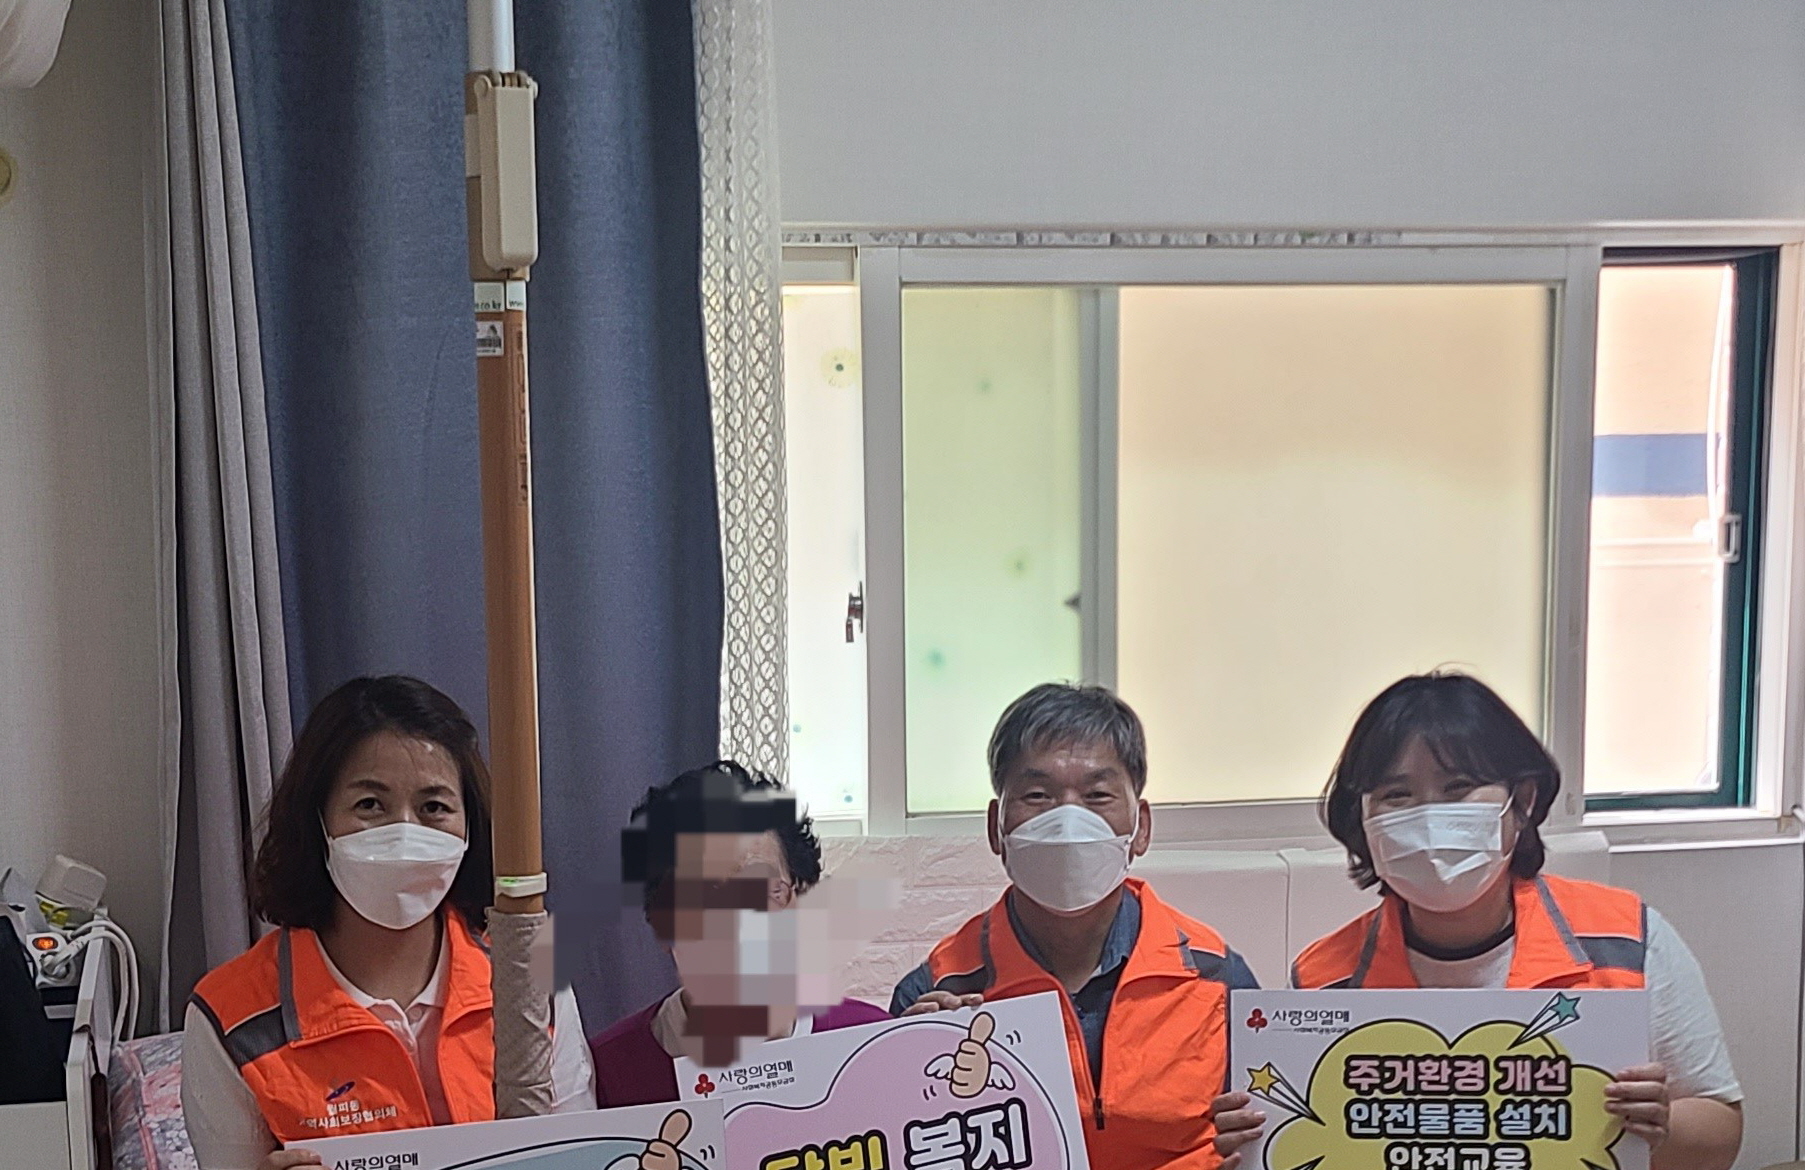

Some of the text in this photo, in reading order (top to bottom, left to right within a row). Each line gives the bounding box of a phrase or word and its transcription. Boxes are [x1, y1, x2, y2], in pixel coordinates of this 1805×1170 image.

[1271, 1009, 1350, 1026] 사랑의열매
[718, 1060, 794, 1086] 사랑의열매
[1346, 1057, 1569, 1094] 주거환경 개선
[326, 1099, 361, 1116] 월피동
[1346, 1100, 1569, 1137] 안전물품 설치
